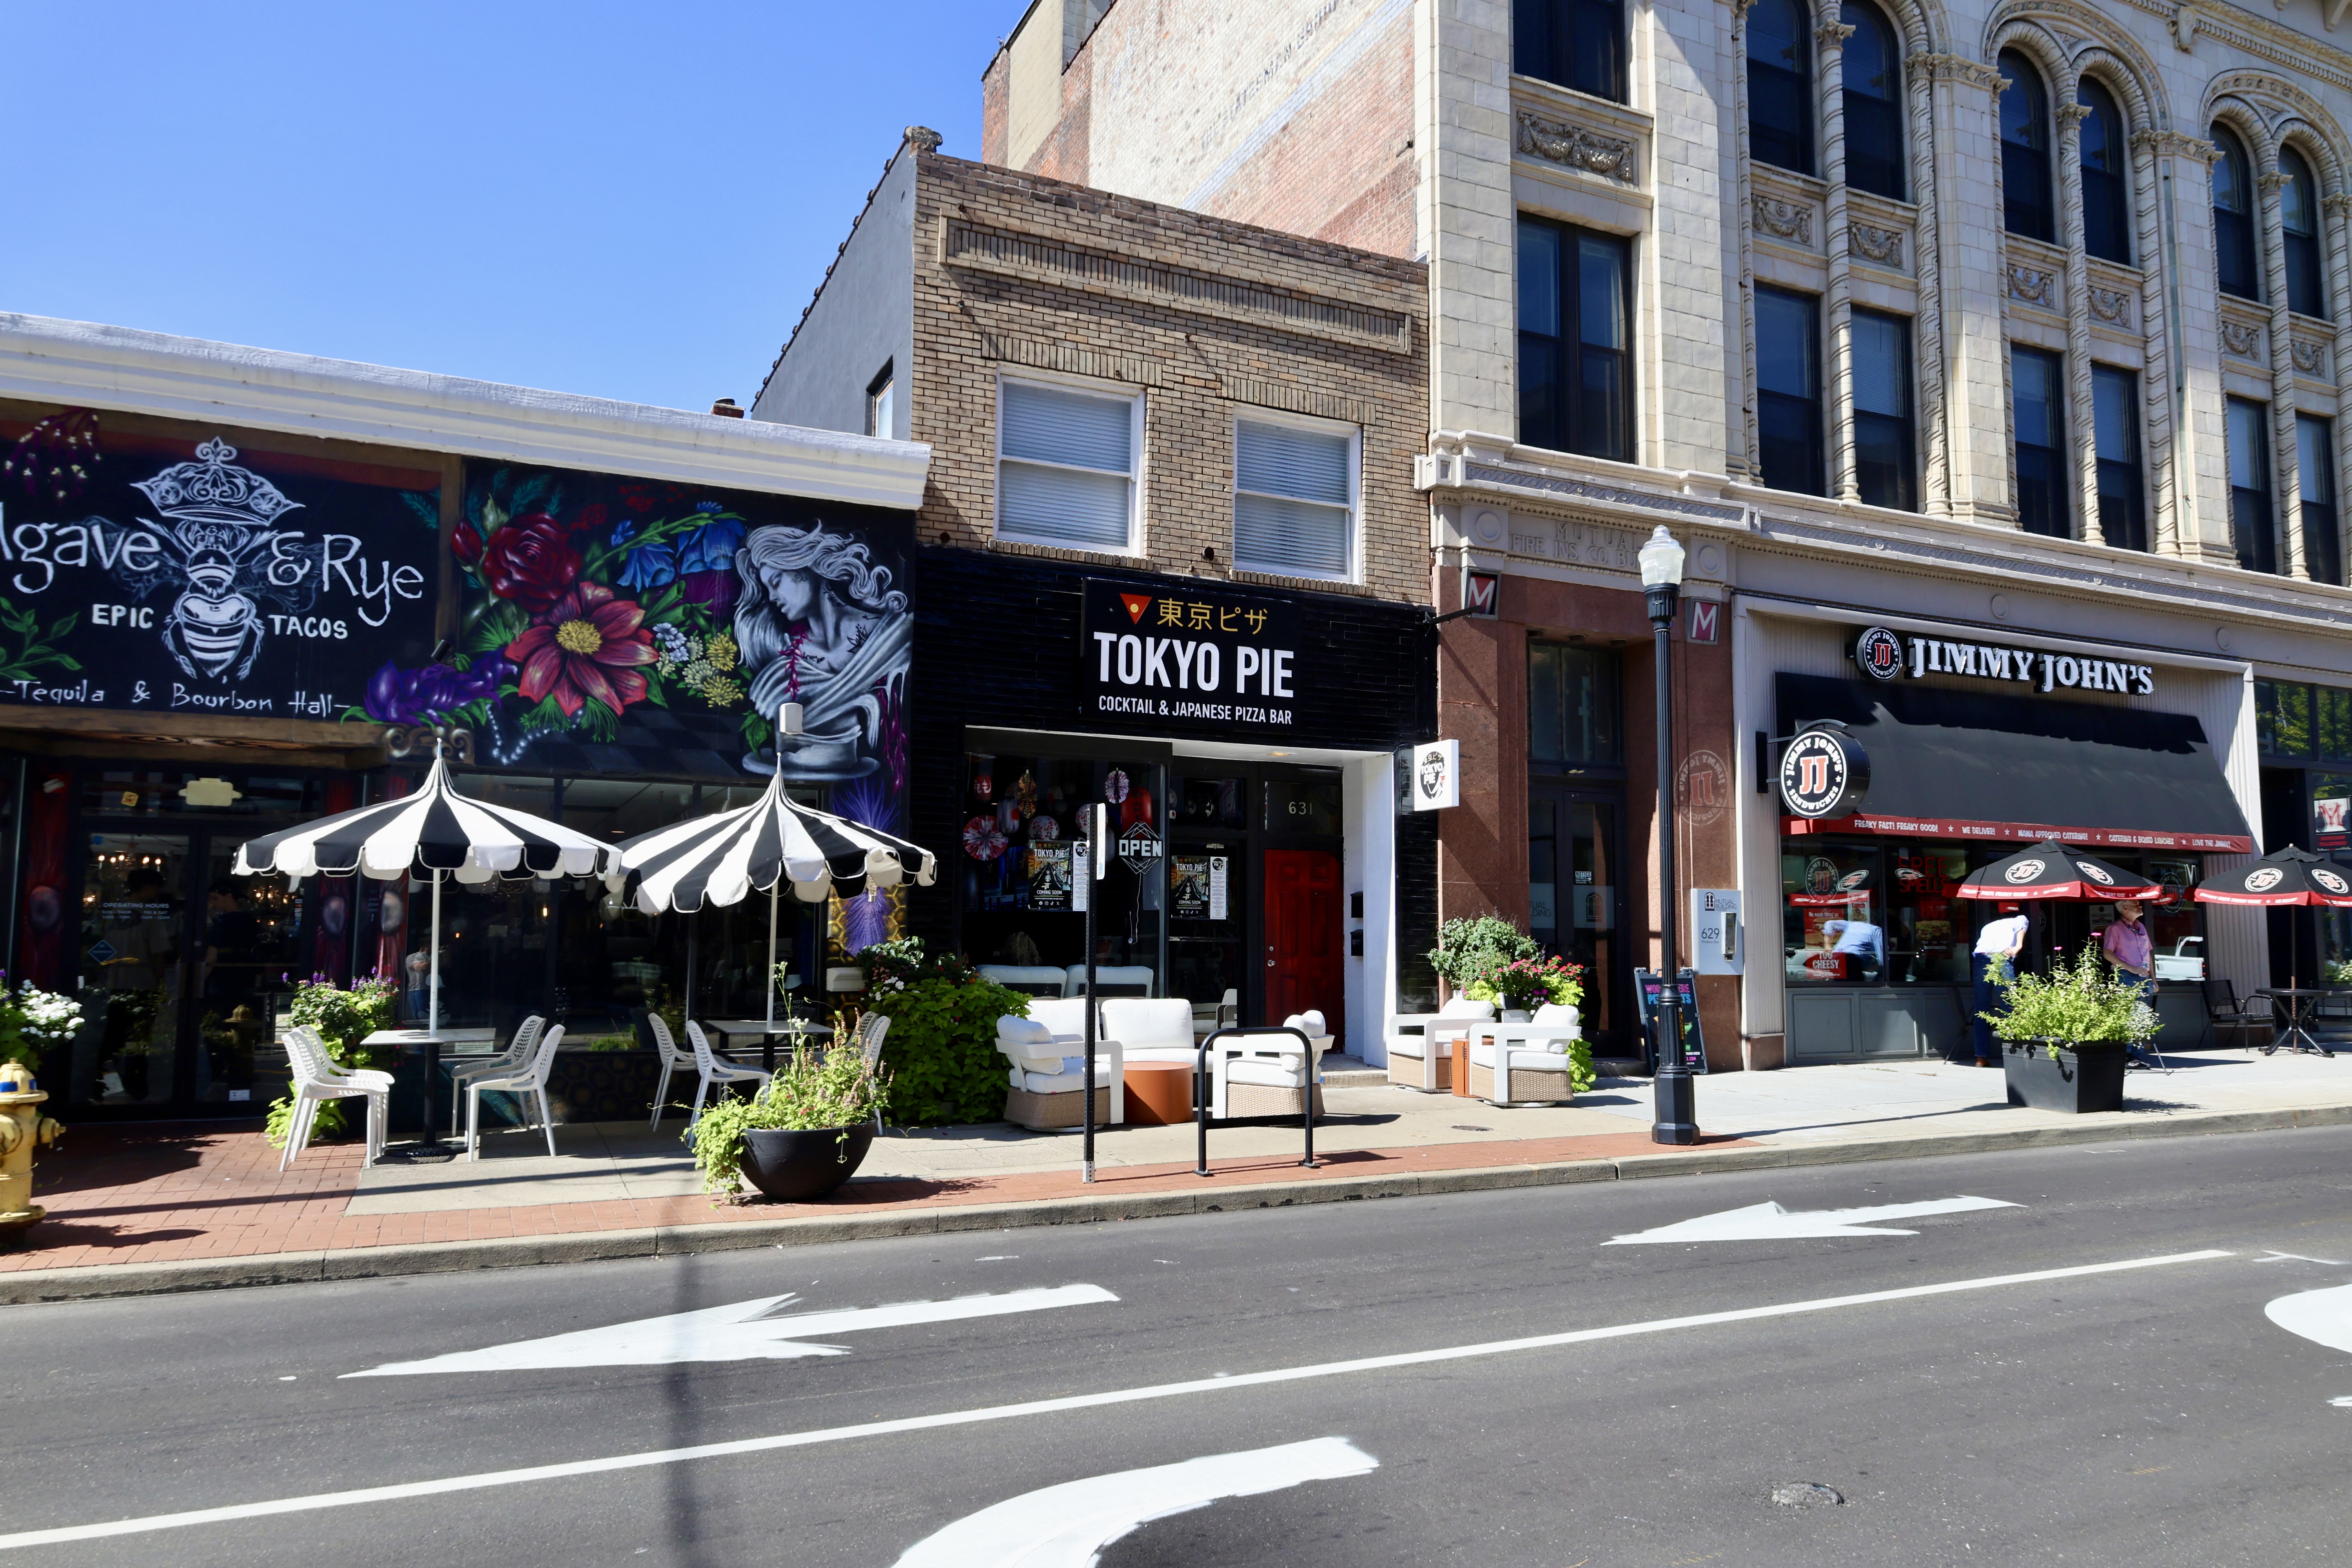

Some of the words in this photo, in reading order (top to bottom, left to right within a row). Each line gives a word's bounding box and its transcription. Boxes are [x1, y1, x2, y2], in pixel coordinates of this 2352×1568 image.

[1512, 534, 1544, 555] FIRE
[1556, 522, 1642, 550] MUTUAL
[267, 532, 310, 585] &
[323, 534, 424, 626] Rye
[1468, 577, 1495, 614] M
[93, 604, 153, 628] EPIC
[269, 614, 348, 639] TACOS
[1157, 598, 1268, 635] 東京ピザ
[1692, 601, 1717, 641] M
[1866, 632, 1881, 653] JIMMY
[1882, 632, 1898, 655] JOHN'S
[1875, 643, 1891, 666] JJ
[1094, 631, 1220, 692] TOKYO
[1236, 645, 1294, 698] PIE
[1868, 661, 1897, 676] SANDWICHES
[1910, 637, 2034, 681] JIMMY
[2040, 653, 2154, 696] JOHN'S
[13, 679, 105, 706] Tequila
[134, 681, 151, 701] &
[172, 683, 272, 711] Bourbon
[289, 690, 332, 718] Hall
[1099, 695, 1156, 715] COCKTAIL
[1159, 700, 1169, 716] &
[1172, 701, 1231, 720] JAPANESE
[1235, 706, 1266, 723] PIZZA
[1270, 710, 1292, 725] BAR
[1786, 738, 1811, 775] JIMMY
[1814, 737, 1843, 772] JOHN'S
[1421, 762, 1443, 775] TOKYO
[1423, 773, 1436, 785] PIE
[1799, 755, 1829, 795] JJ
[1289, 801, 1312, 815] 631
[1789, 786, 1839, 810] SANDWICHES
[1854, 819, 1877, 829] FREAKY
[1878, 821, 1895, 830] FAST!
[1896, 822, 1919, 831] FREAKY
[1920, 823, 1938, 832] GOOD!
[1962, 826, 1971, 834] WE
[1972, 826, 1996, 835] DELIVER!
[1034, 849, 1053, 857] TOKYO
[1119, 840, 1162, 857] OPEN
[1898, 857, 1948, 878] FREE
[1815, 871, 1829, 891] JJ
[1701, 927, 1720, 939] 629
[1812, 960, 1839, 969] CHEESY
